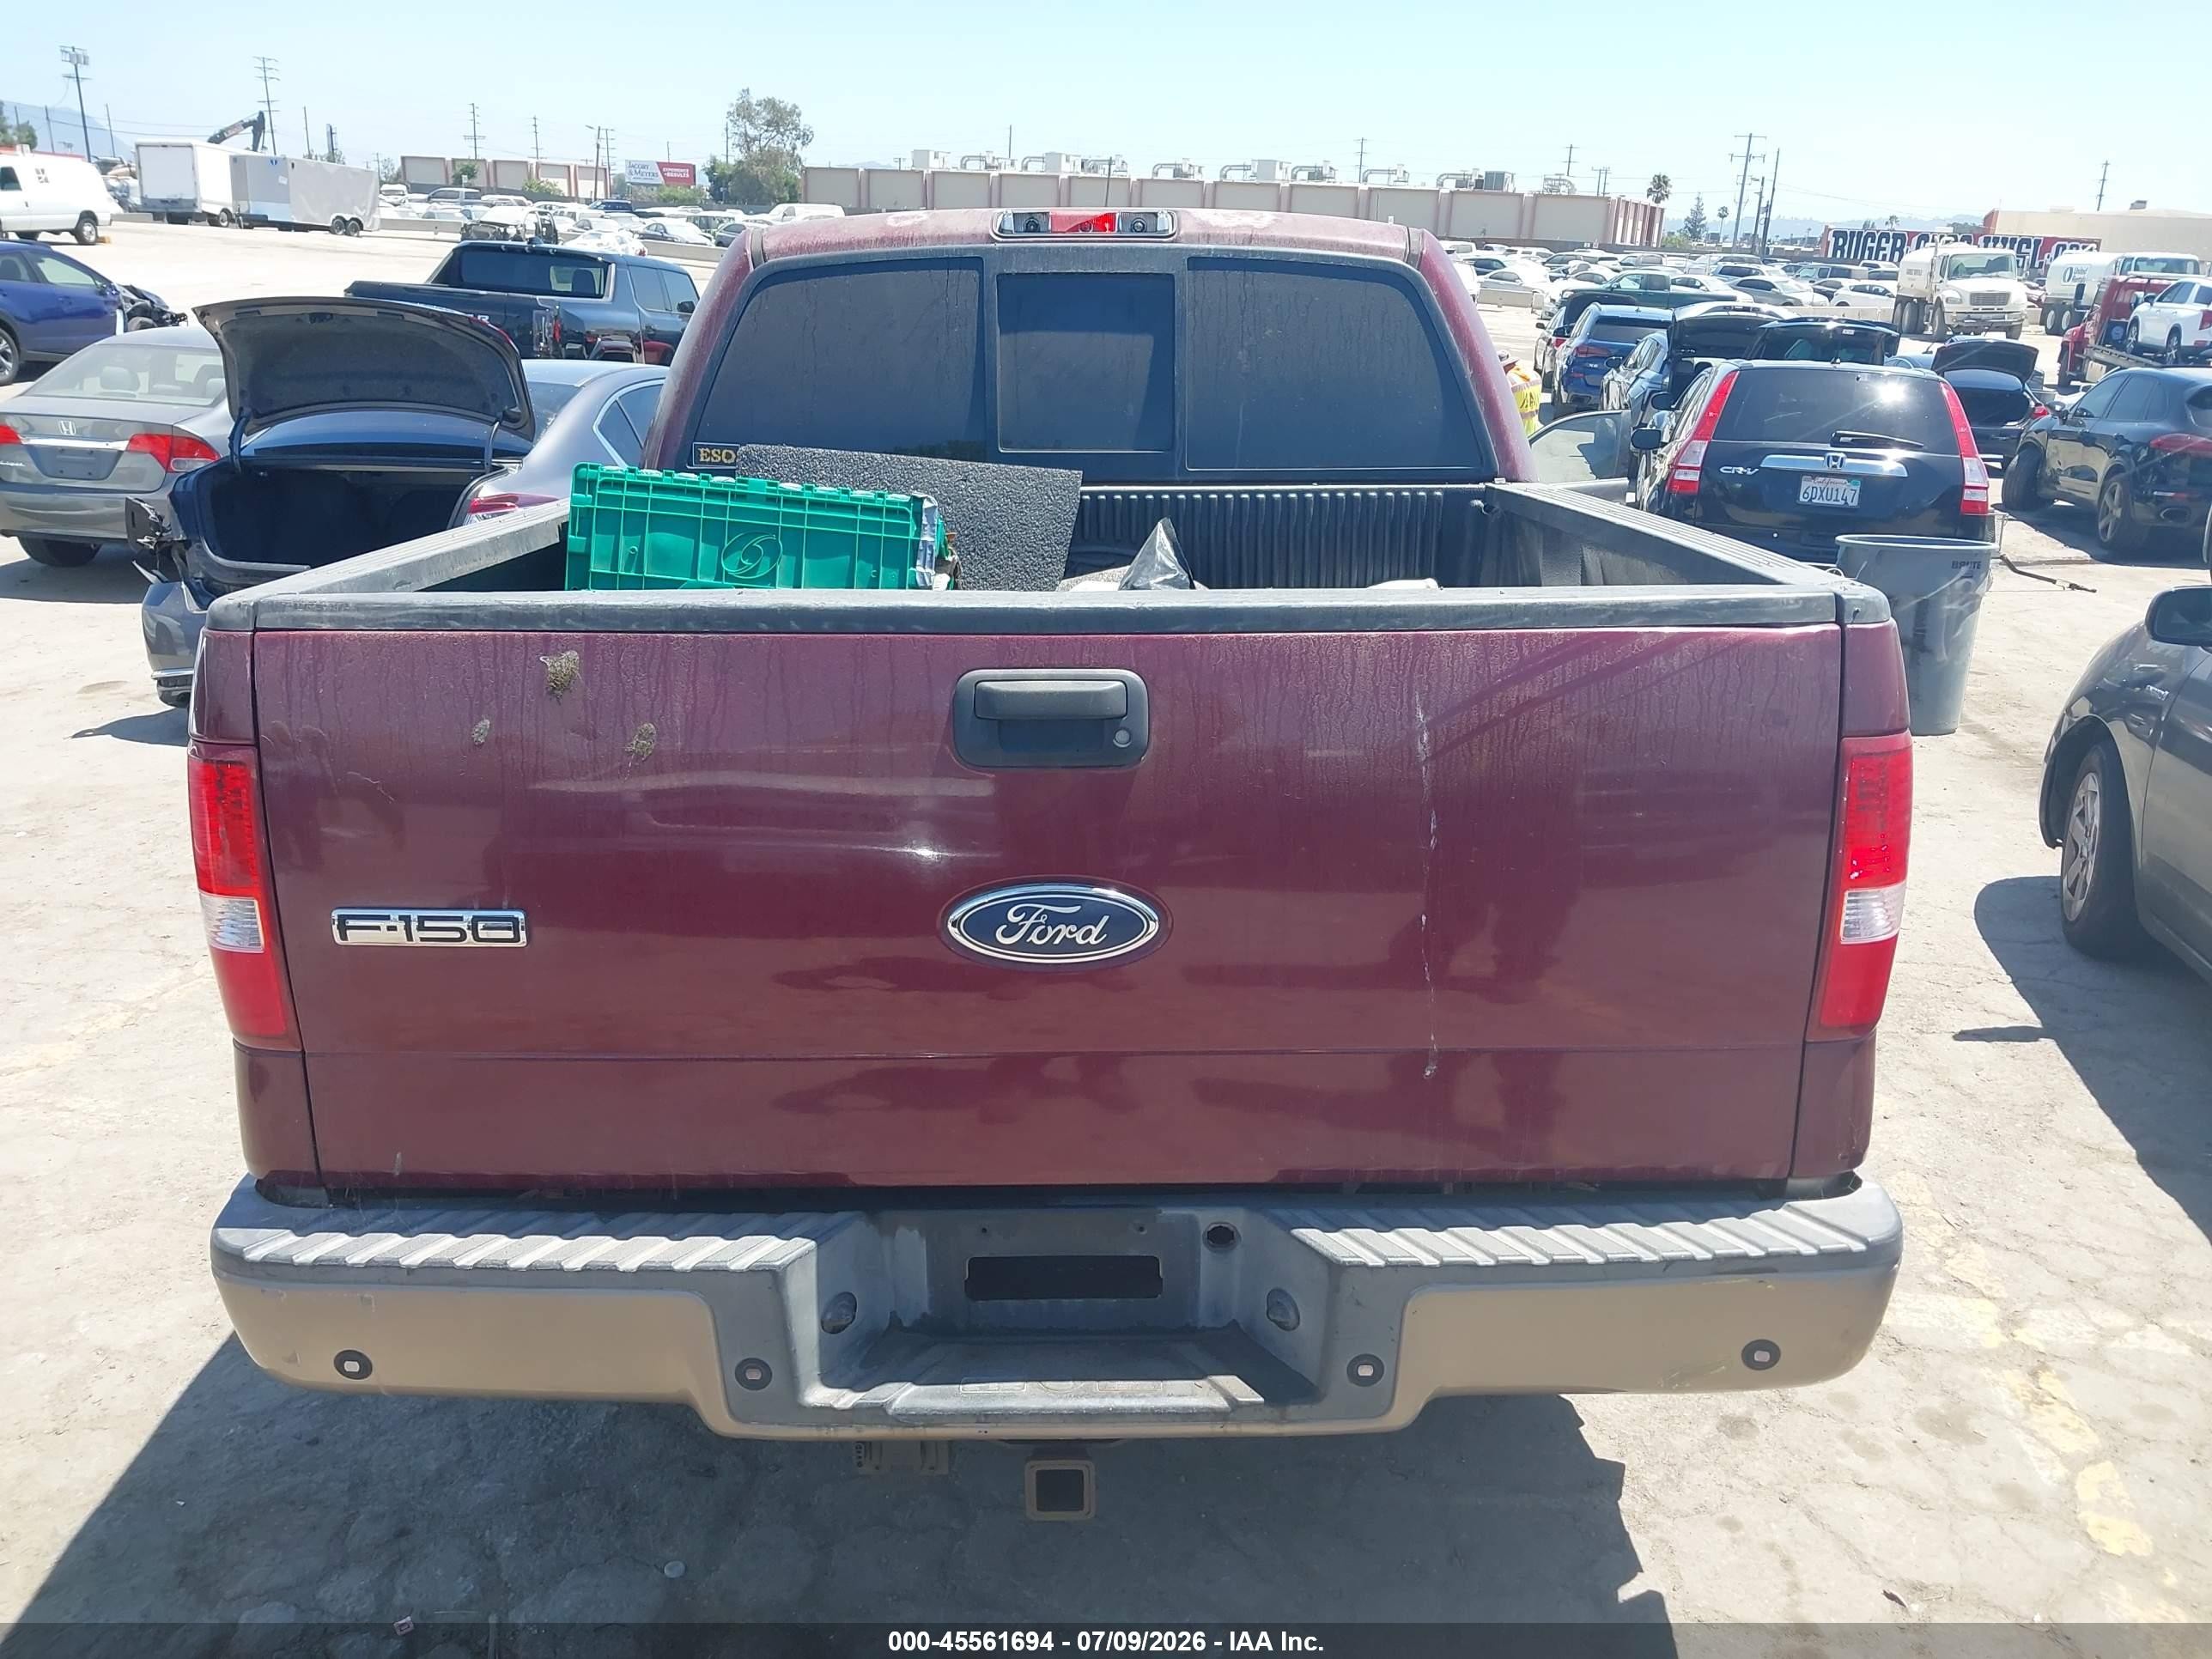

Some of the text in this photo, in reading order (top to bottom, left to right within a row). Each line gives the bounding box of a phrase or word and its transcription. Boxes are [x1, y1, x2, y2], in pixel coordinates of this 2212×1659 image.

[1720, 466, 1759, 475] CR-V
[1802, 486, 1857, 503] 6DXU147
[337, 915, 520, 943] F-150
[995, 903, 1109, 945] Ford
